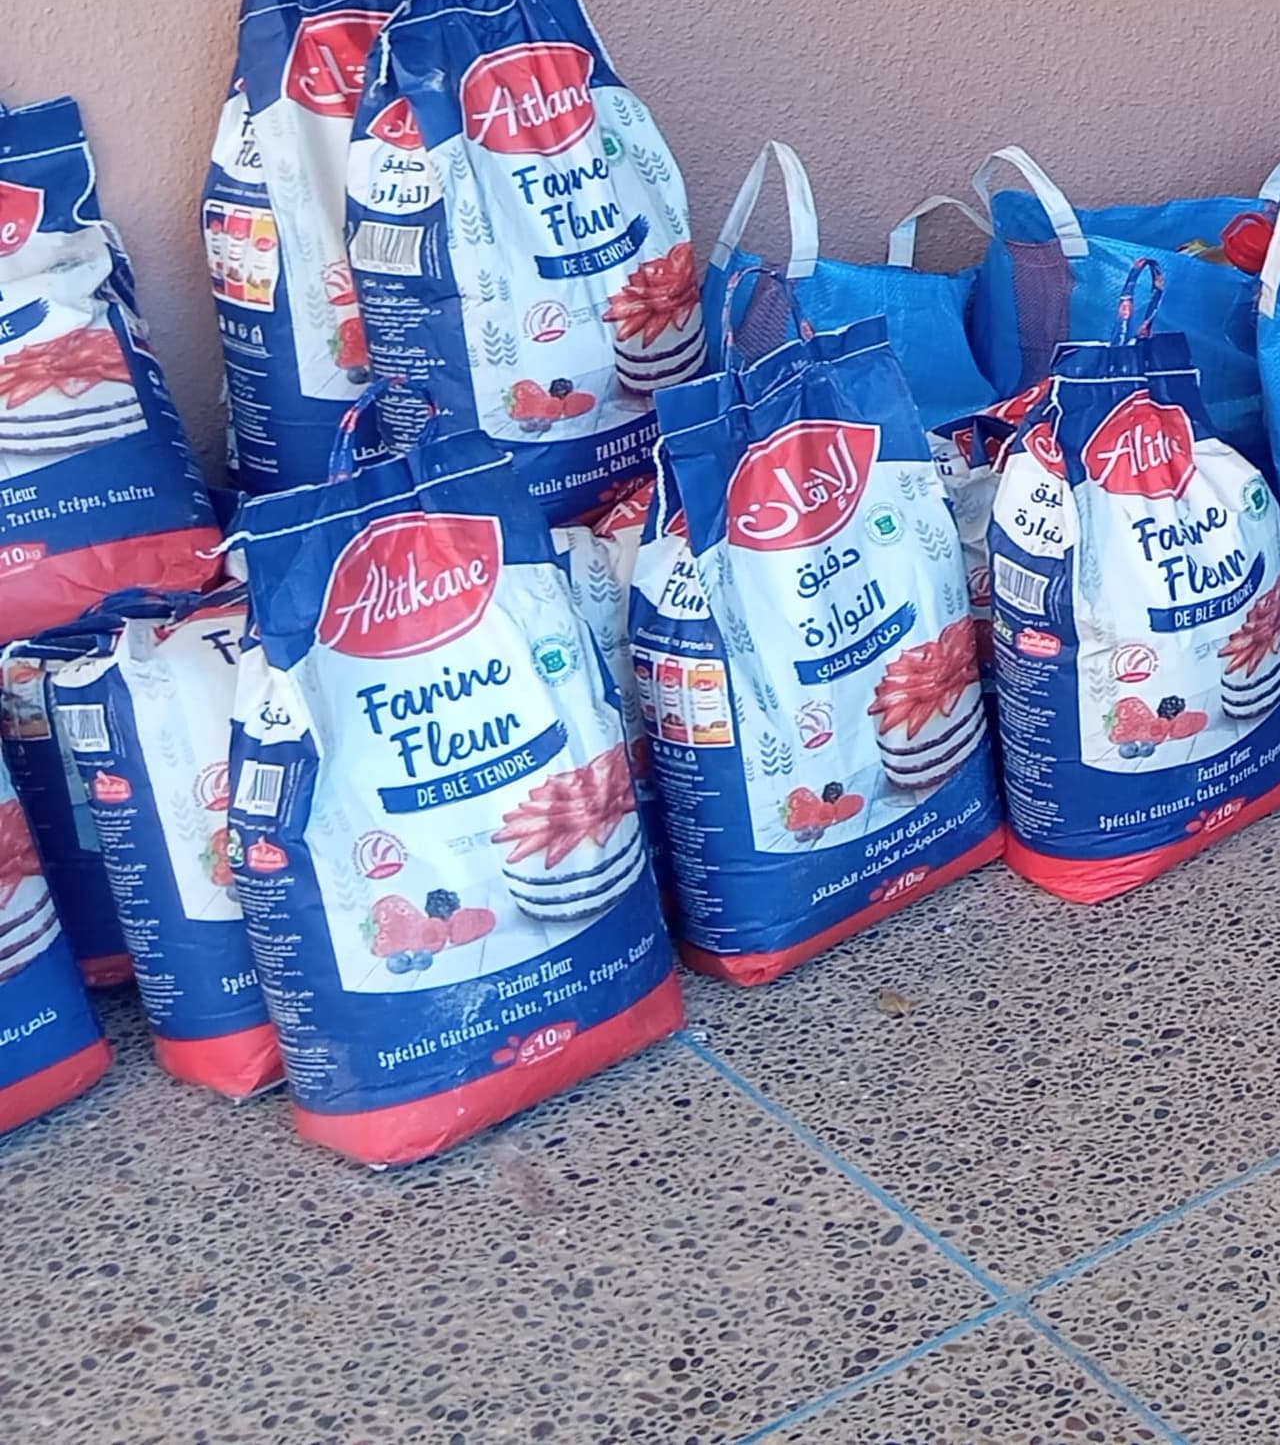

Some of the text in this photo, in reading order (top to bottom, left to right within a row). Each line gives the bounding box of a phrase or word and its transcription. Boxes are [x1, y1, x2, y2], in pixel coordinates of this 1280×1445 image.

[1, 485, 38, 506] Fleur
[107, 485, 156, 503] Gaufres
[797, 545, 861, 598] دقيق
[798, 579, 886, 648] النوارة
[1174, 611, 1191, 628] DE
[356, 659, 511, 735] Farine
[389, 713, 521, 778] Fleur
[416, 749, 538, 808] DE BLÉ TENDRE
[904, 810, 938, 837] دقيق
[497, 956, 573, 1001] Farine Fleur
[20, 1007, 58, 1036] خاص
[378, 1037, 438, 1070] Spéciale
[501, 1000, 543, 1025] Cakes,
[543, 981, 588, 1005] Tartes,
